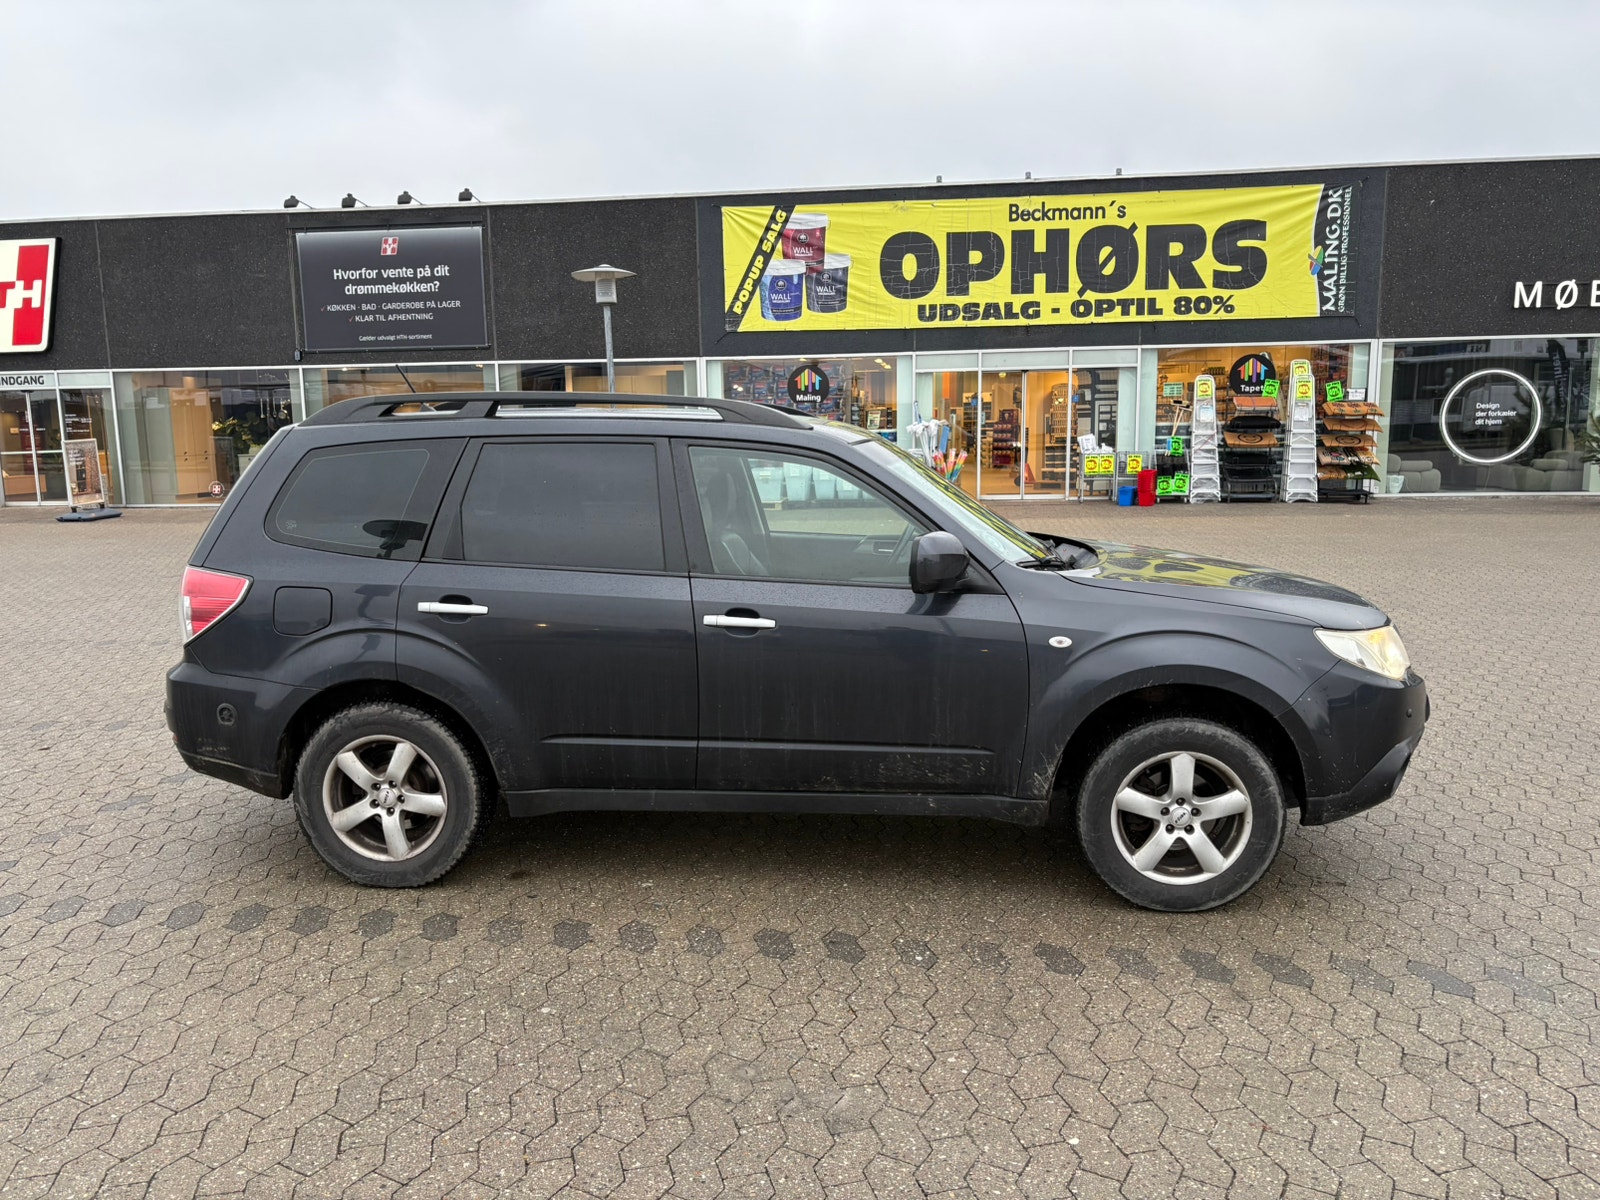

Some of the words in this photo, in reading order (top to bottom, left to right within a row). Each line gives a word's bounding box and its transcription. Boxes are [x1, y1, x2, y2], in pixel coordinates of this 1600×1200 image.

[1341, 186, 1352, 254] PROFESSIONEL
[792, 246, 814, 254] WALL
[1322, 187, 1342, 311] MALING.DK
[733, 255, 764, 314] POPUP
[762, 209, 787, 253] SALG
[880, 219, 1267, 300] OPHØRS
[333, 267, 378, 280] Hvorfor
[381, 268, 414, 279] vente
[416, 265, 431, 279] på
[433, 265, 450, 277] dit
[1340, 256, 1348, 285] BILLIG
[344, 281, 440, 295] drømmekøkken?
[770, 292, 792, 300] WALL
[1338, 286, 1346, 313] GRØN
[326, 304, 356, 312] KØKKEN
[361, 303, 377, 311] BAD
[382, 302, 425, 310] GARDEROBE
[426, 300, 437, 308] PÅ
[437, 300, 461, 308] LAGER
[917, 301, 1041, 322] UDSALG
[1070, 297, 1163, 318] OPTIL
[1173, 294, 1235, 315] 80%
[355, 314, 374, 322] KLAR
[387, 313, 434, 321] AFHENTNING
[0, 375, 45, 386] NDGANG
[1240, 384, 1265, 393] Tapet
[796, 394, 822, 403] Maling
[1476, 402, 1500, 411] Design
[1484, 418, 1503, 427] hjem
